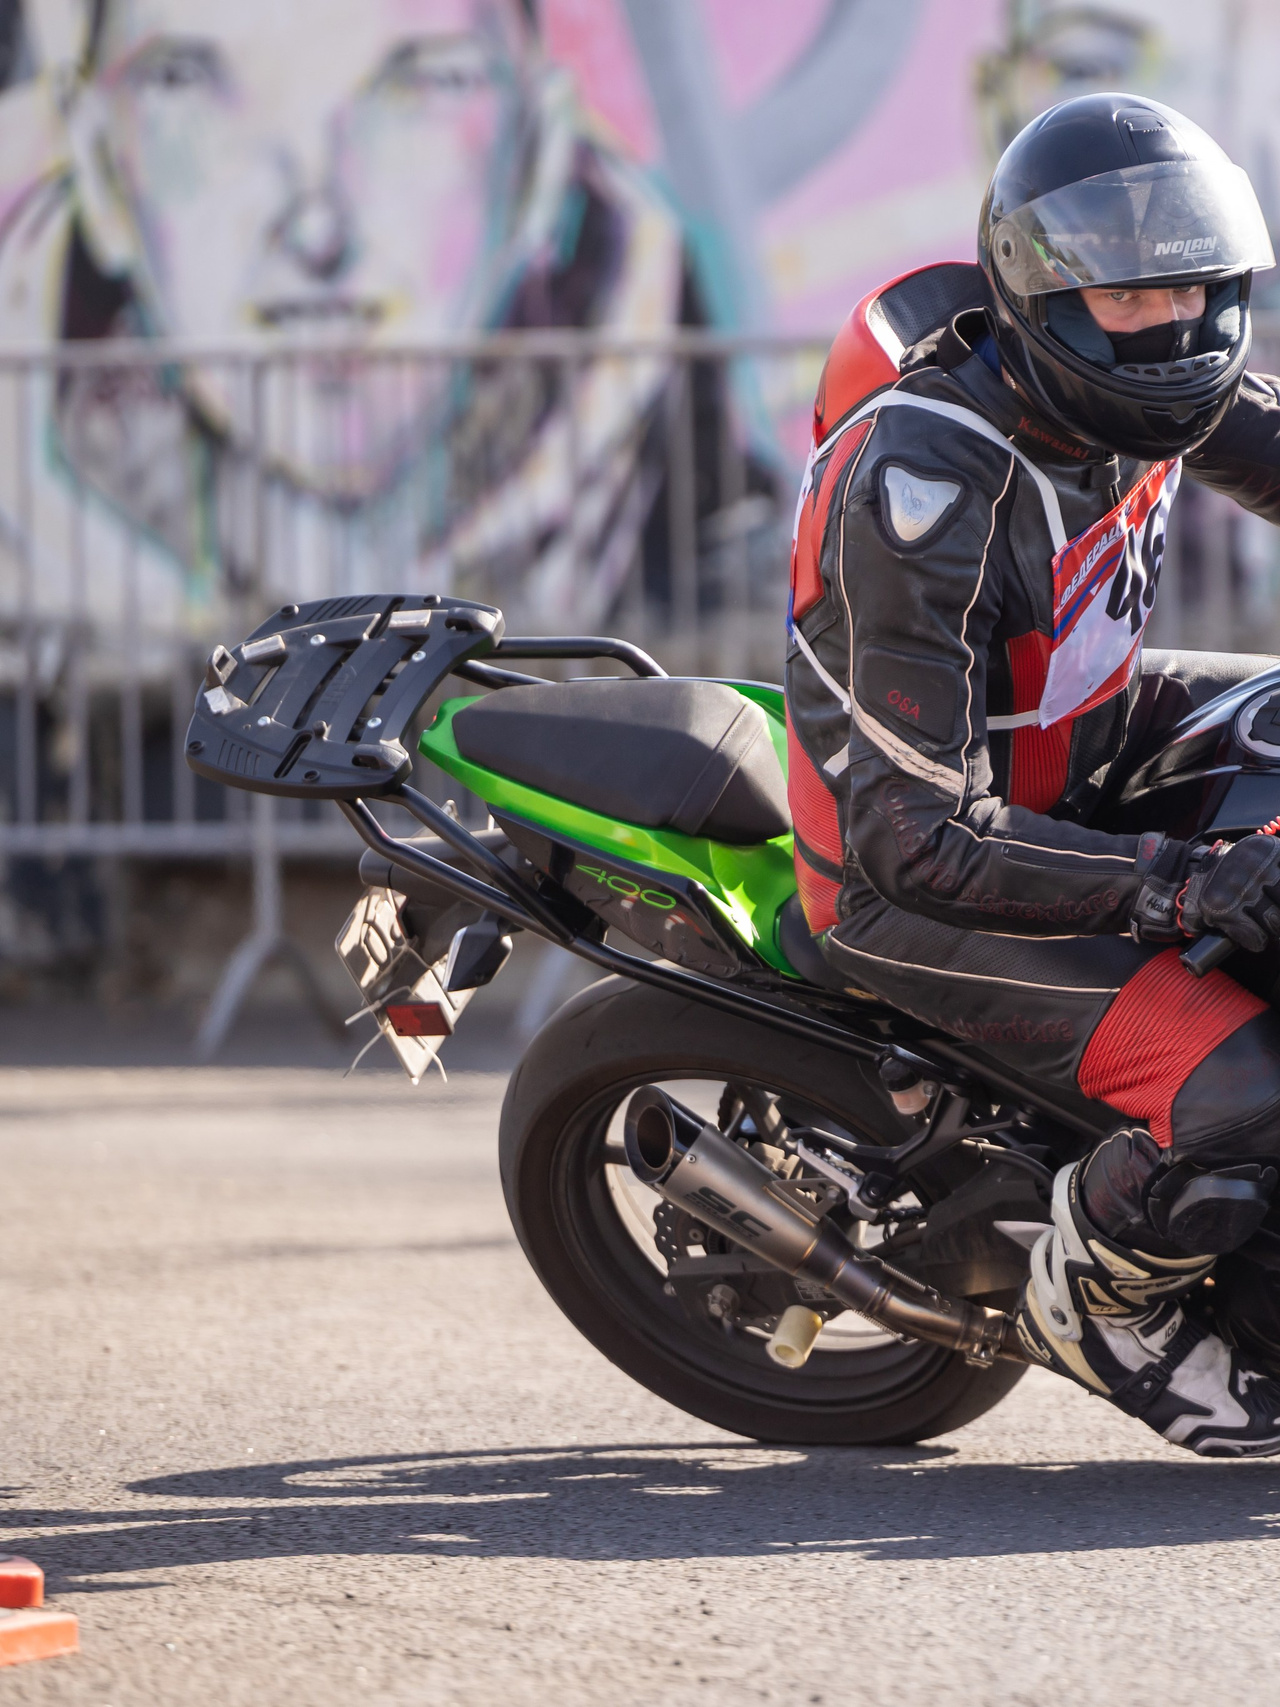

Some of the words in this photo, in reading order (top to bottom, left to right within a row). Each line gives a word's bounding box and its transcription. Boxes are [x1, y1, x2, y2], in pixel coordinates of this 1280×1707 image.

[1154, 236, 1217, 257] NOLAN
[1017, 416, 1089, 460] Kawasaki
[576, 864, 677, 909] 400
[690, 1186, 773, 1237] SC
